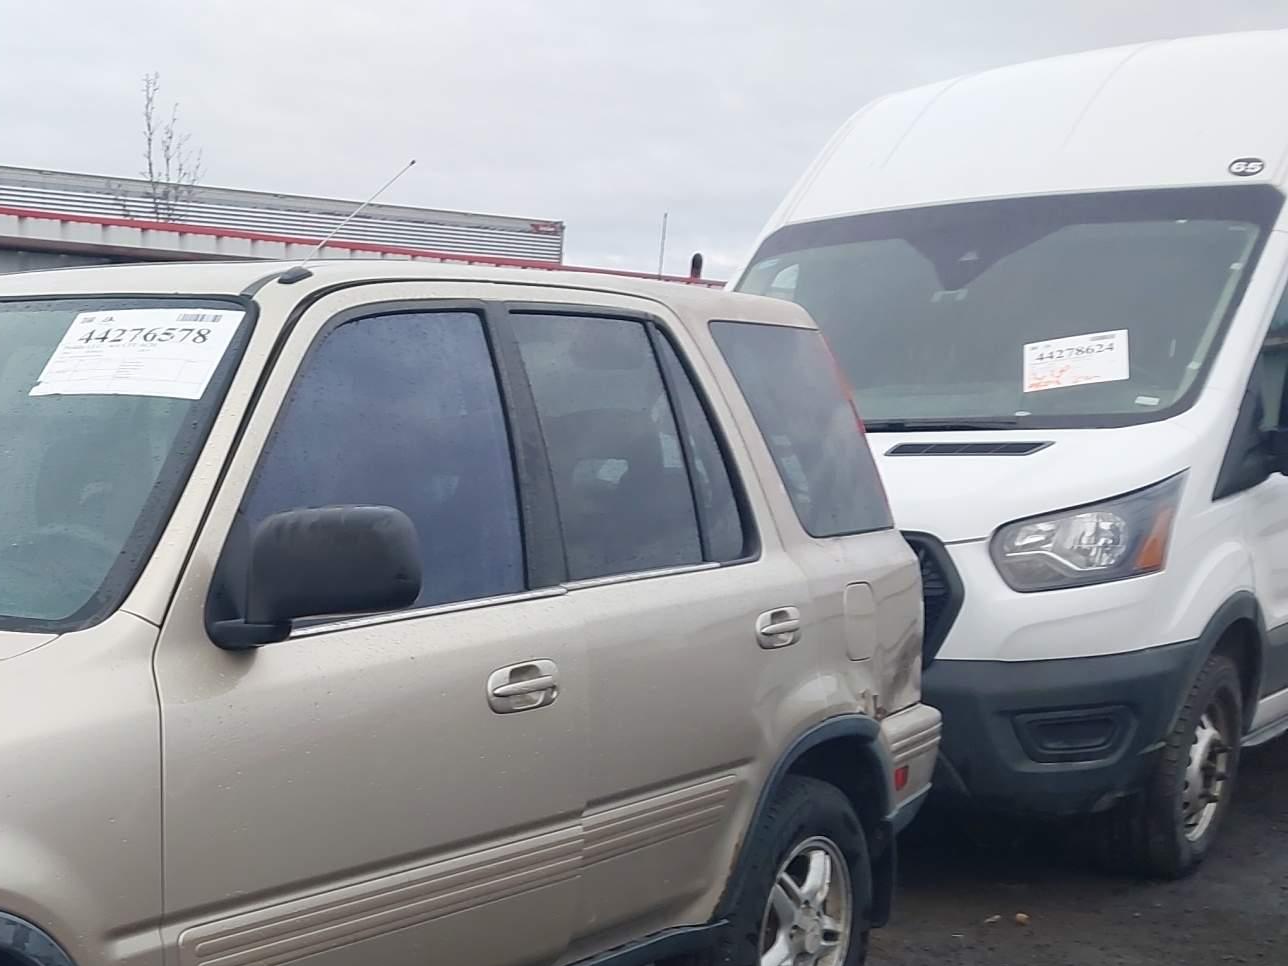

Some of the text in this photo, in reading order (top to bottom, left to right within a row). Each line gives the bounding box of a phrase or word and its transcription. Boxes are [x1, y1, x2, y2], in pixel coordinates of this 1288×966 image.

[1230, 161, 1264, 173] 65
[77, 328, 212, 344] 44276578
[1035, 343, 1114, 360] 44278624
